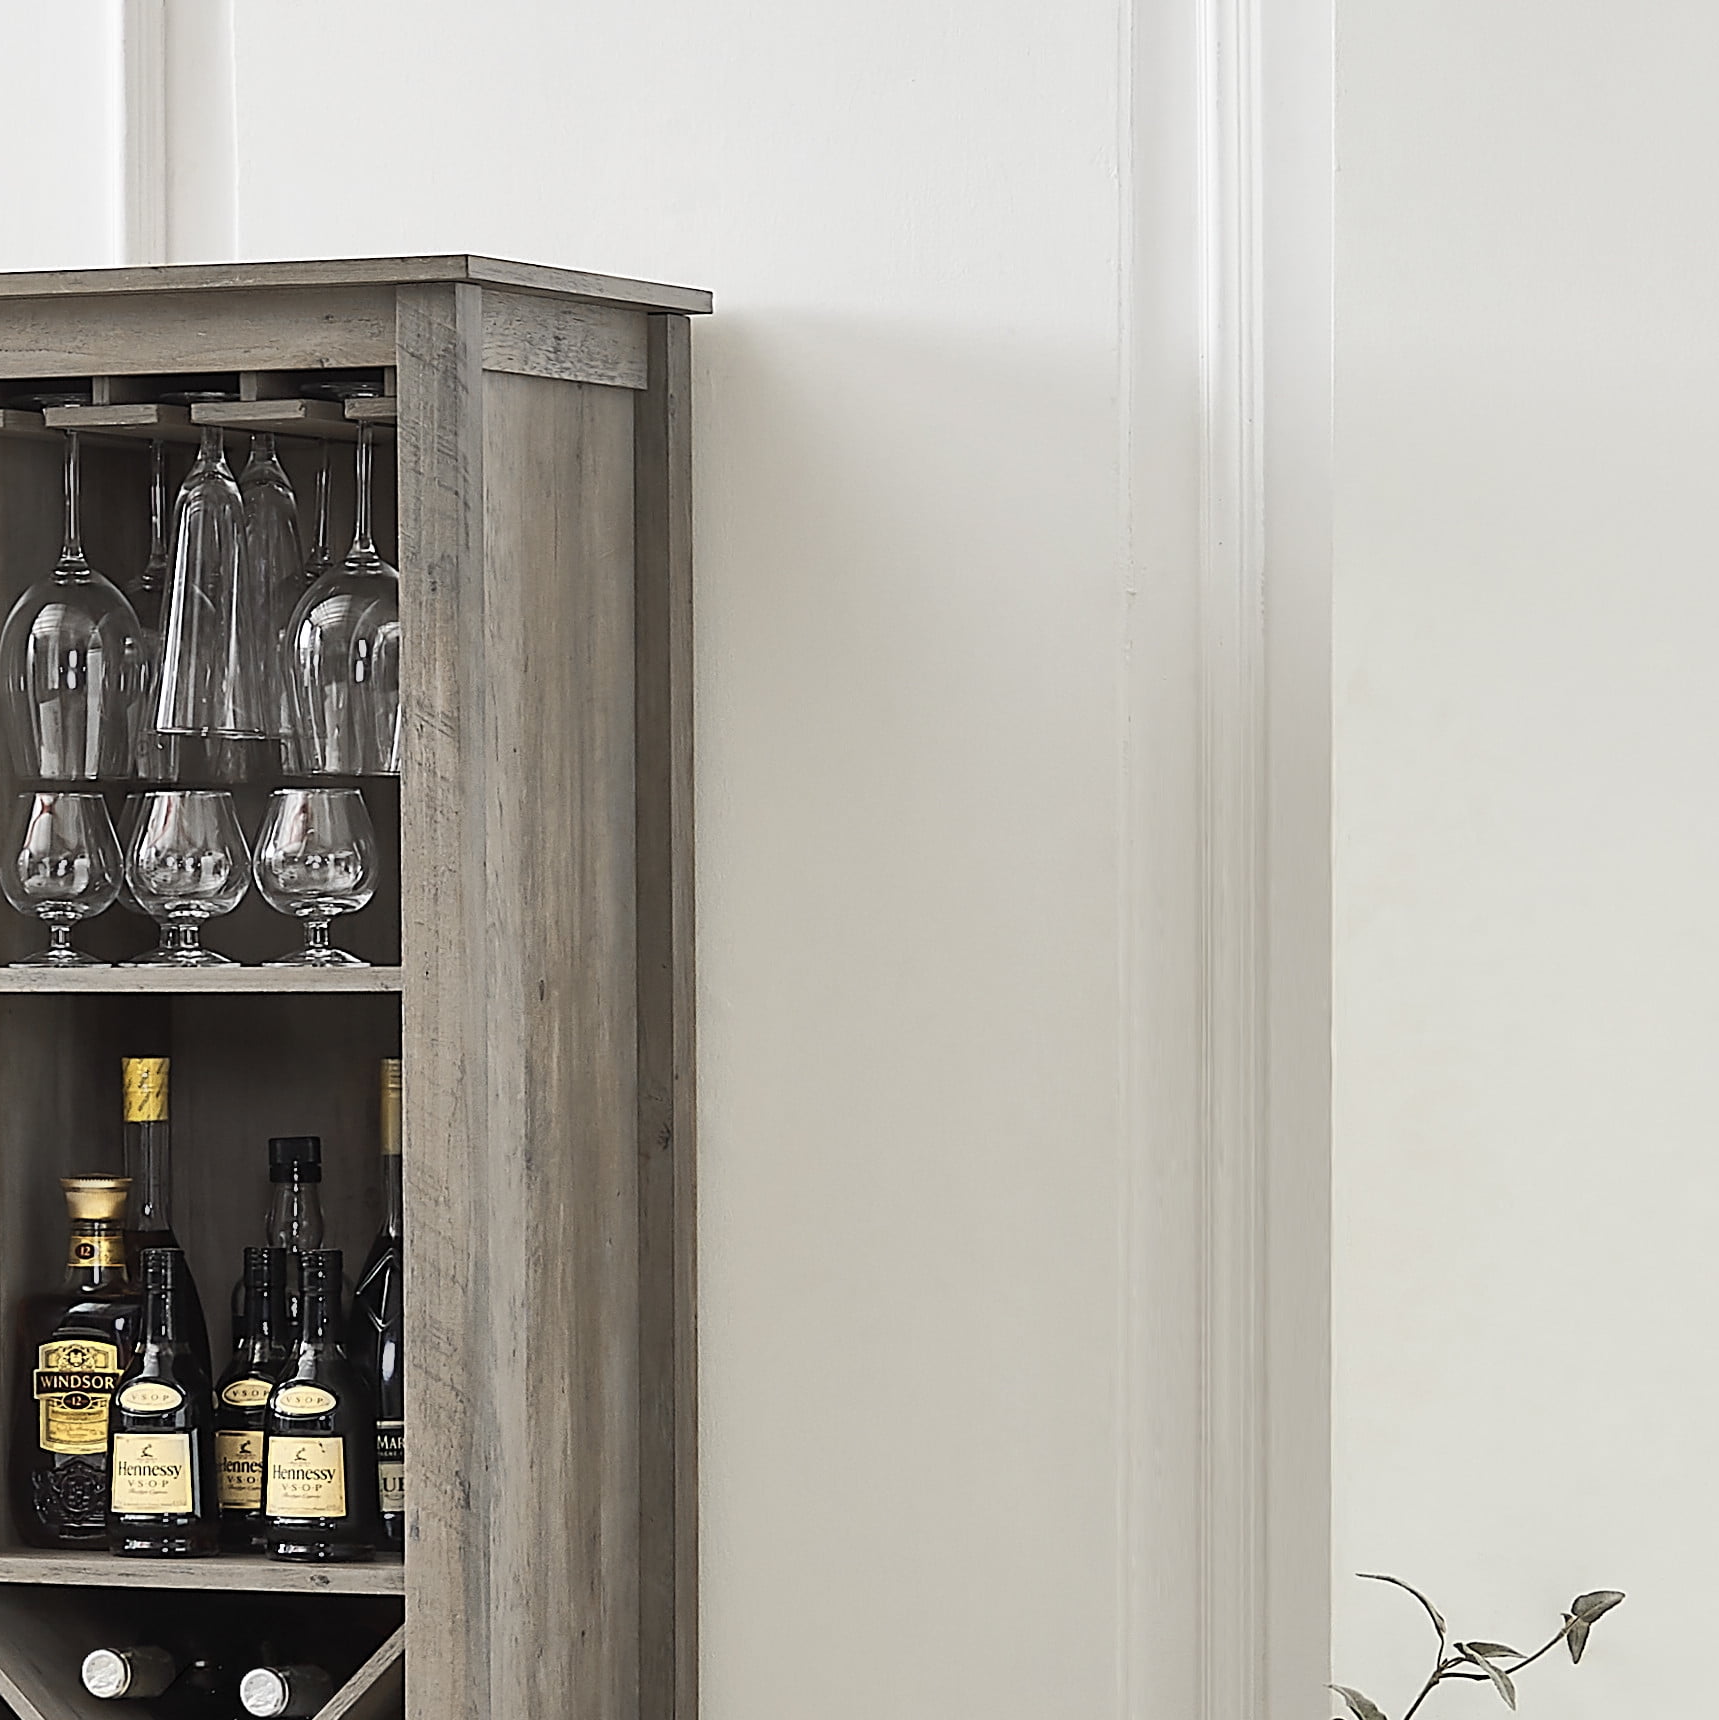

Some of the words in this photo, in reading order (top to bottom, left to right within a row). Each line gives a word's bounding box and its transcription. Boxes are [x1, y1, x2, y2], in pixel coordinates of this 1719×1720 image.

[80, 1246, 91, 1257] 12
[40, 1375, 115, 1389] WINDSOR
[71, 1396, 82, 1406] 12
[118, 1461, 182, 1479] Hennessy
[273, 1465, 337, 1483] Hennessy
